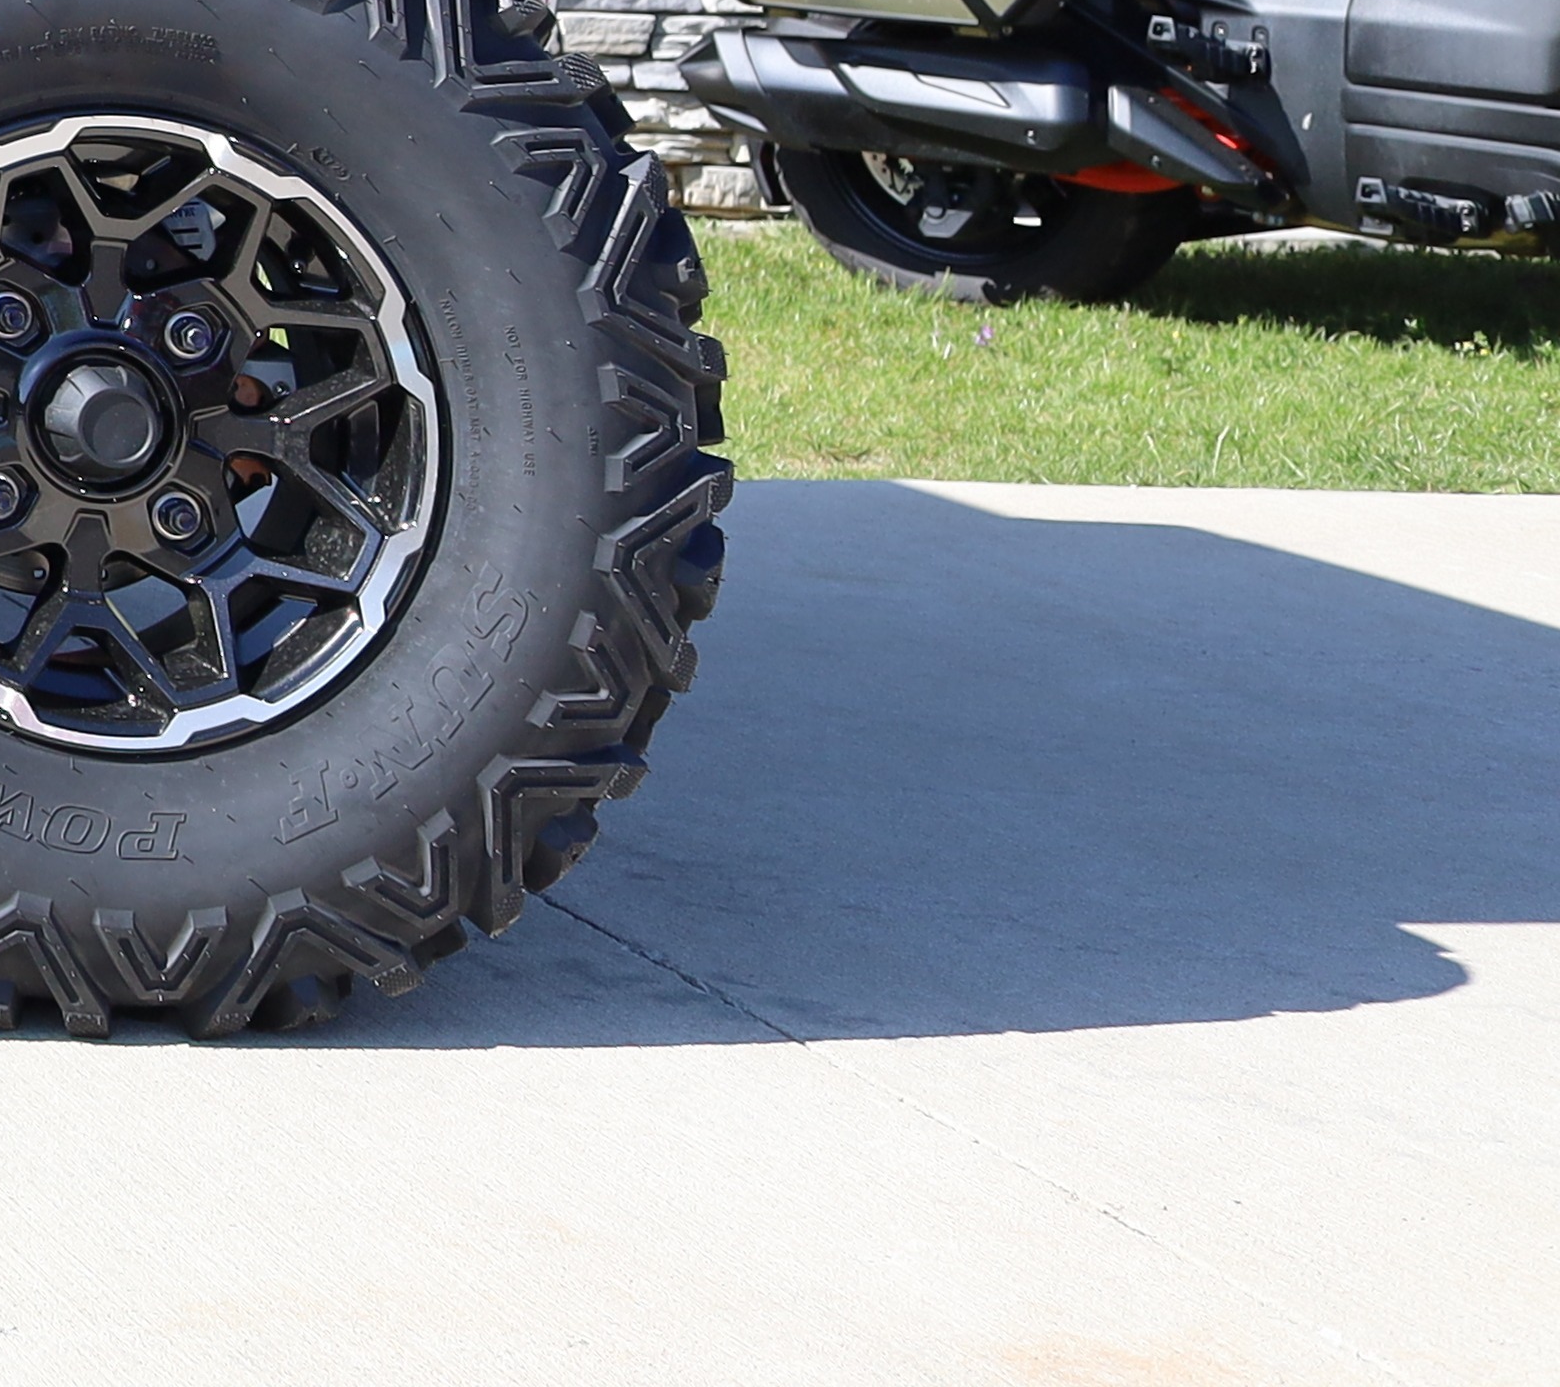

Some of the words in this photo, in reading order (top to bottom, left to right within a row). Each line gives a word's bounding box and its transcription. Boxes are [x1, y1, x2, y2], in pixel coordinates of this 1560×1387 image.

[502, 324, 521, 350] NOT
[512, 355, 528, 382] FOR
[517, 387, 536, 444] HIGHWAY
[521, 452, 537, 478] USE
